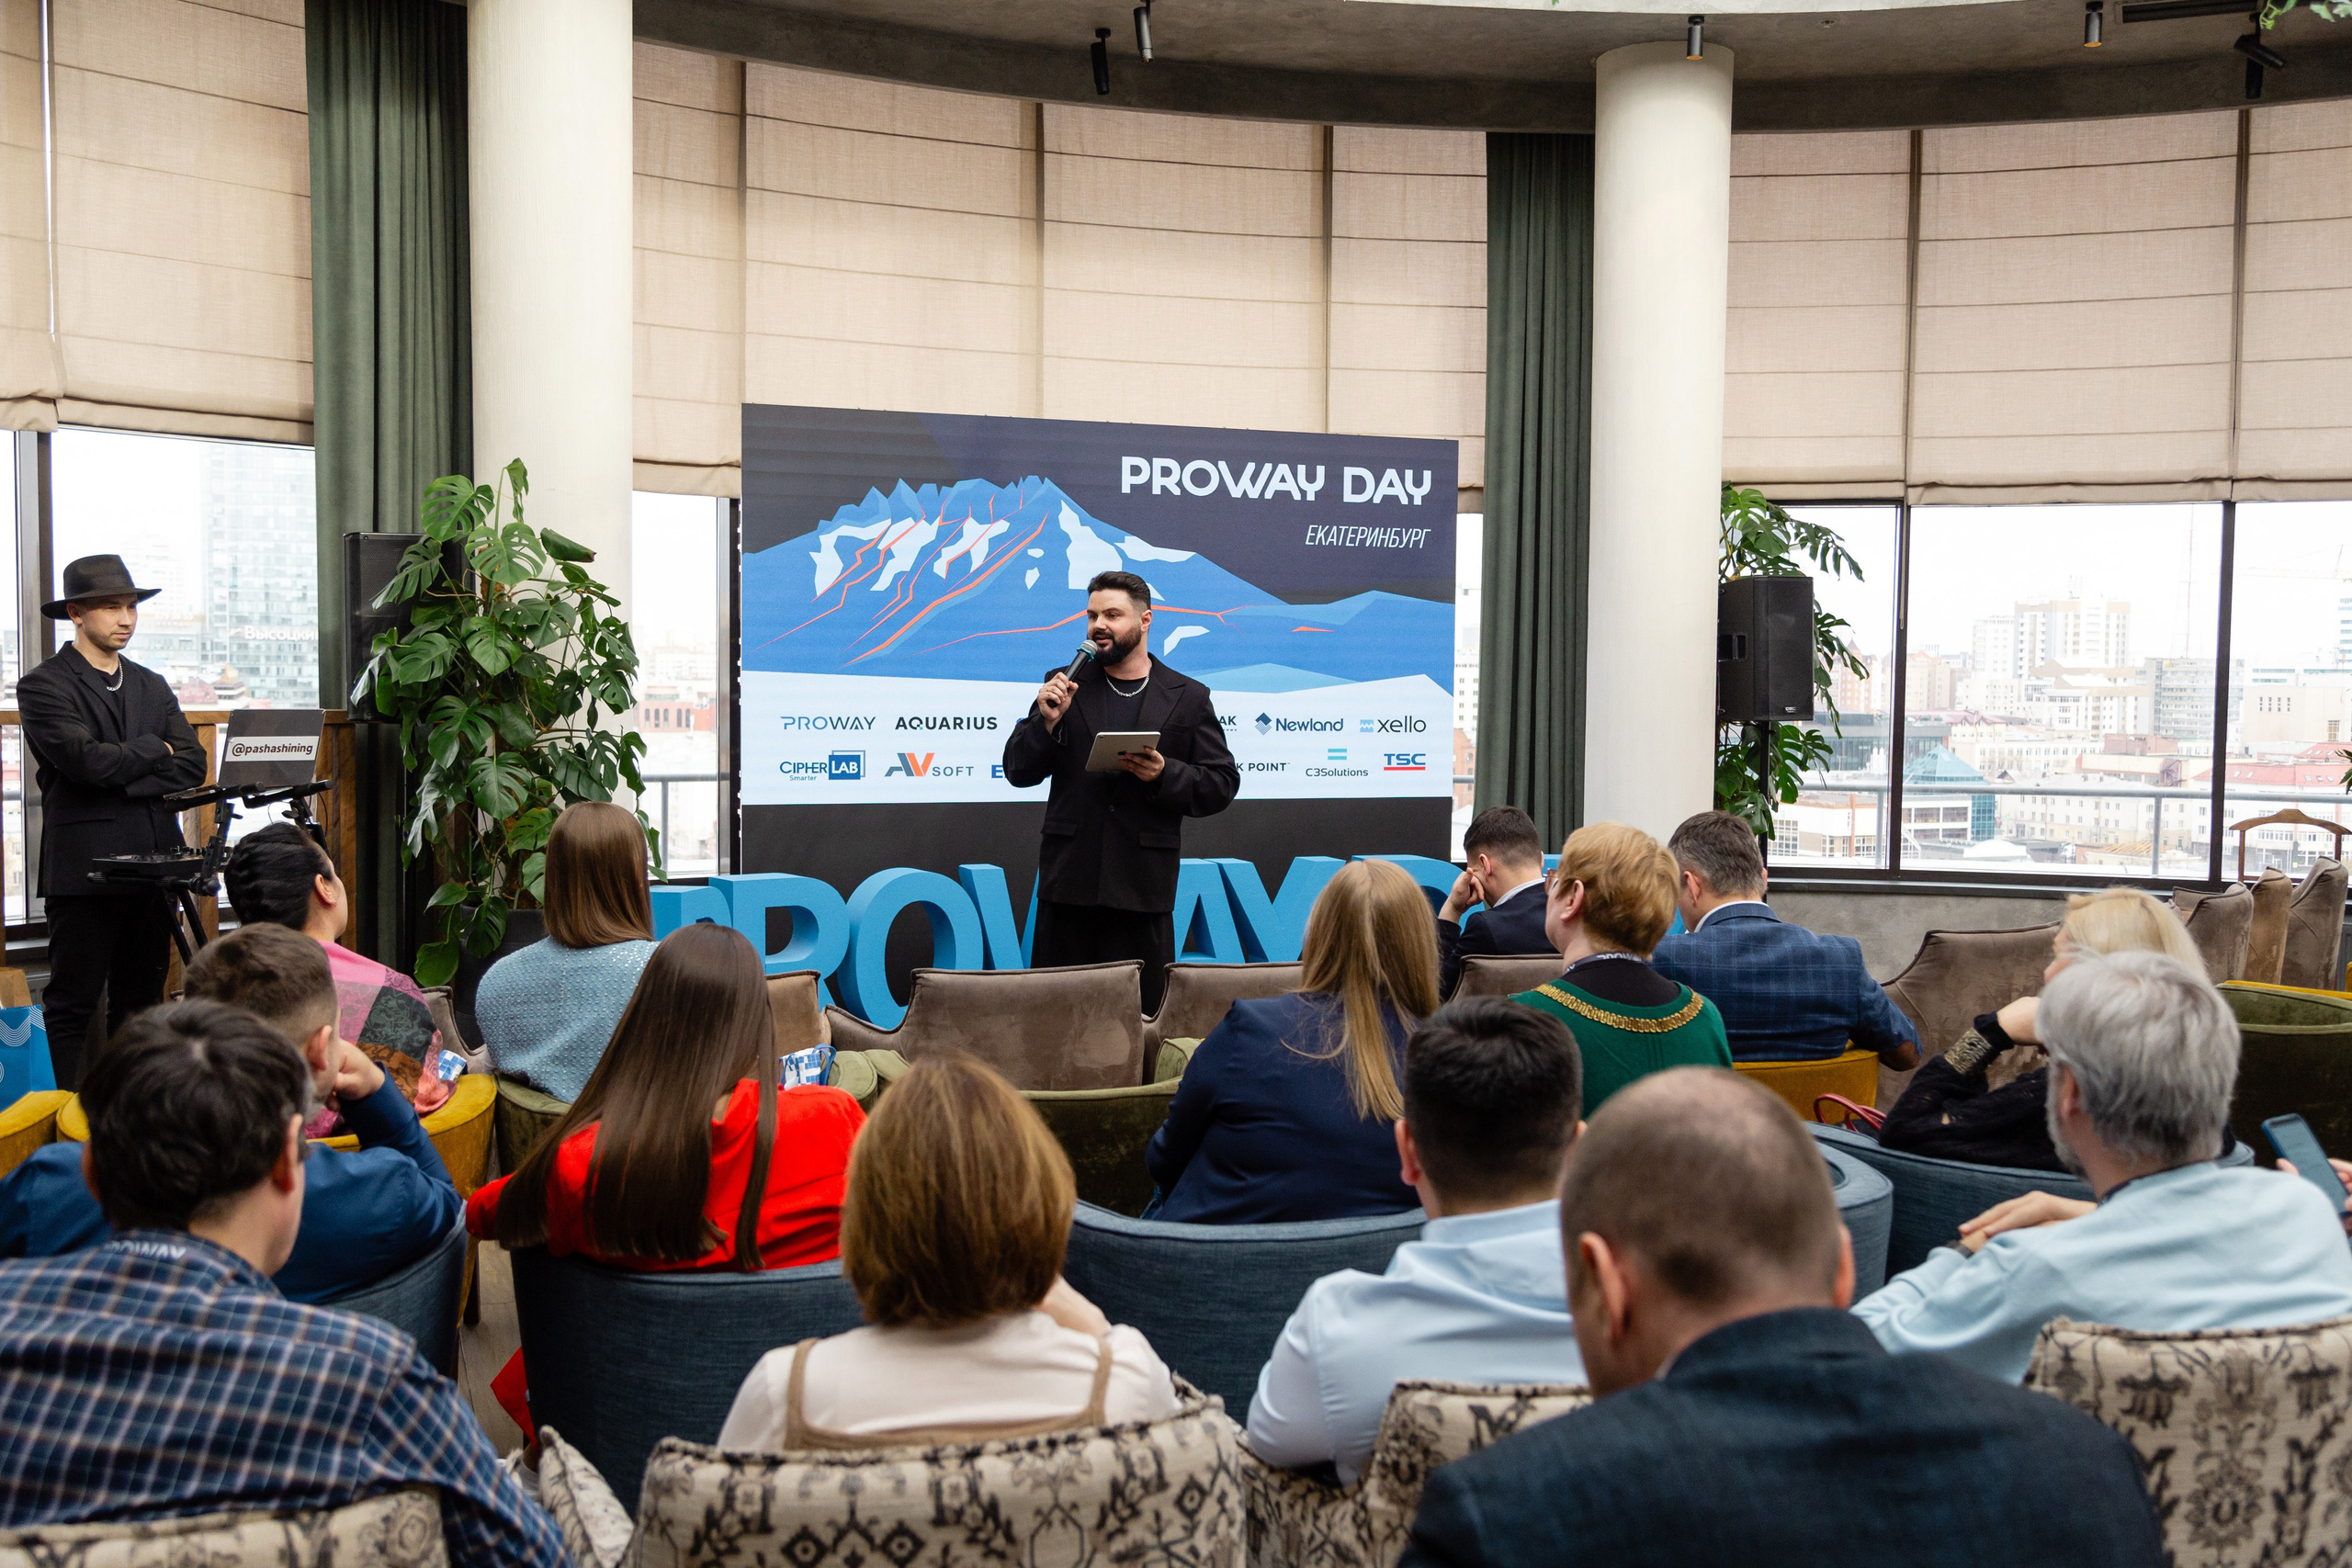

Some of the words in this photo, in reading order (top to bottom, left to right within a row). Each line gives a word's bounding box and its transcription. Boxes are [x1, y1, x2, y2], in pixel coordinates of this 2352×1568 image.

[1121, 456, 1326, 501] PROWAY
[1343, 467, 1432, 505] DAY
[1305, 525, 1431, 548] ЕКАТЕРИНБУРГ
[244, 625, 318, 641] Высоцки
[780, 716, 876, 730] PROWAY
[895, 716, 998, 730] AQUARIUS
[1275, 717, 1344, 732] Newland
[1376, 715, 1427, 733] xello
[232, 742, 313, 757] @pashashining
[1384, 753, 1426, 766] TSC
[932, 766, 974, 777] SOFT
[1248, 762, 1287, 772] POINT
[1306, 767, 1369, 777] C3Solutions
